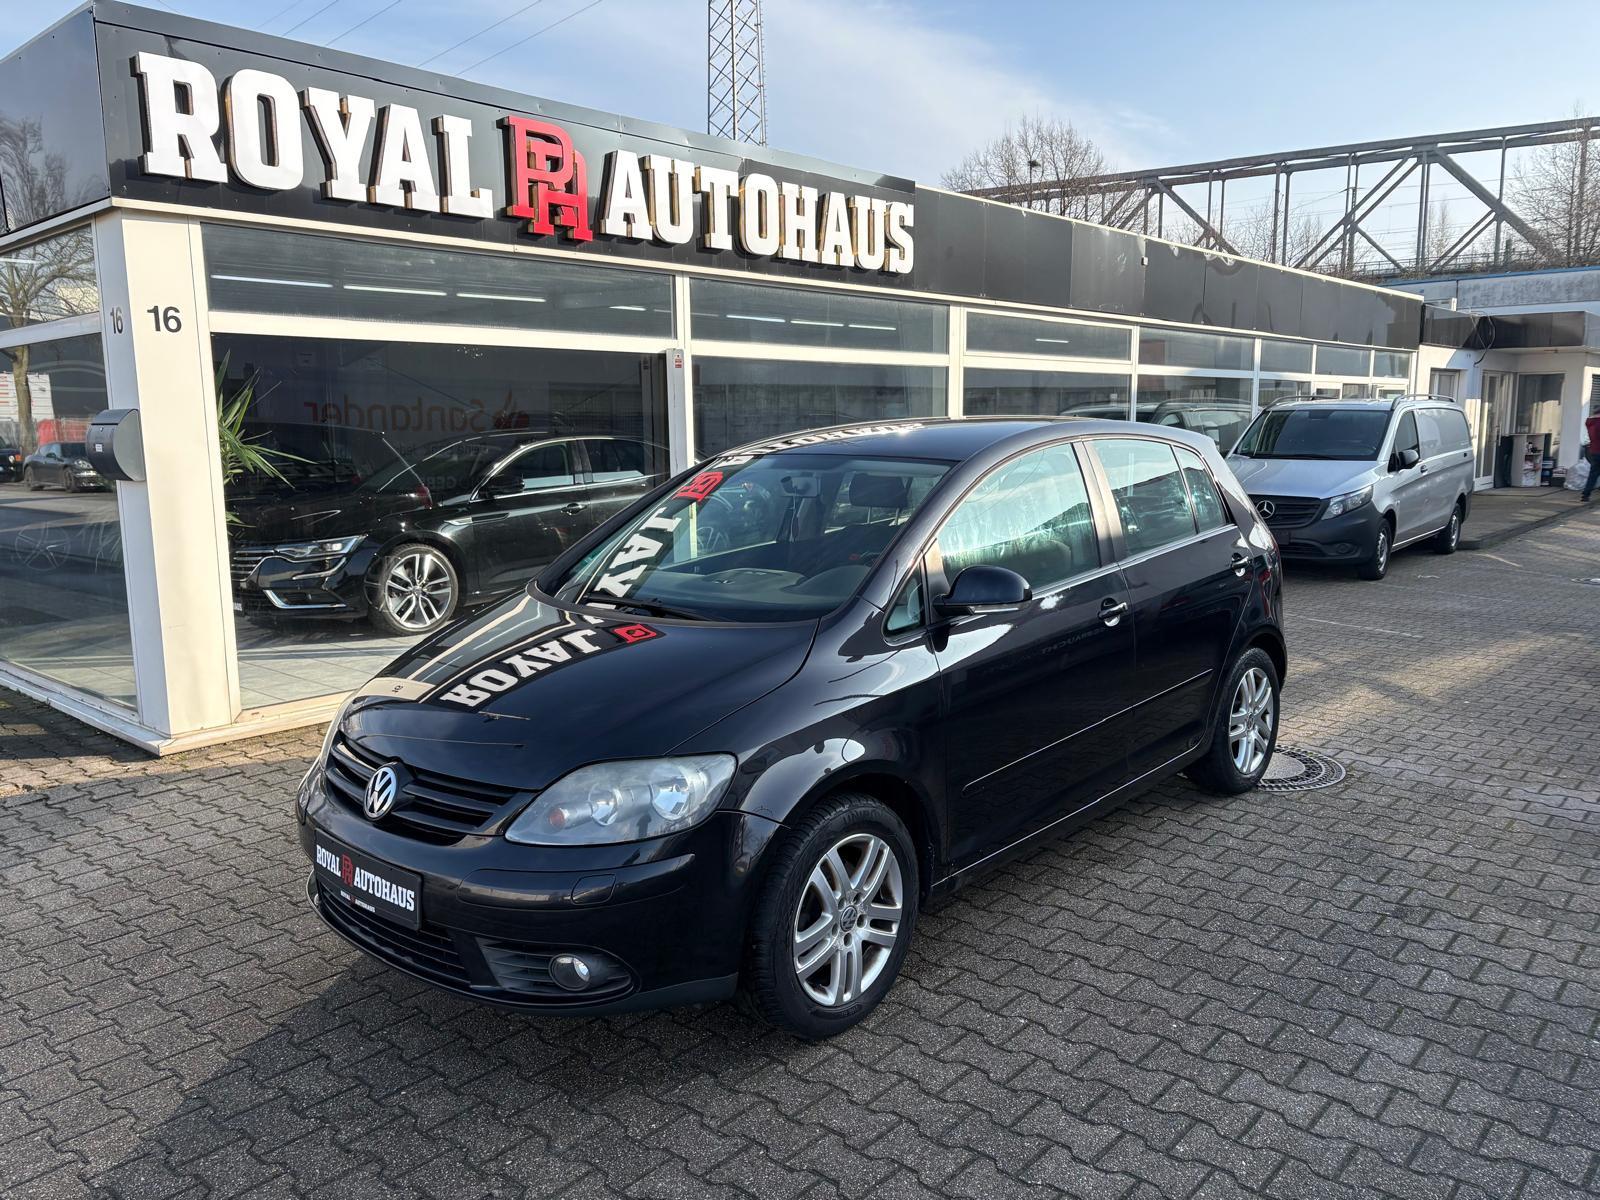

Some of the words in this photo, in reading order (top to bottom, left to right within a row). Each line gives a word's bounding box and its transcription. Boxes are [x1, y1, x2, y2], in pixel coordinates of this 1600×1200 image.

[131, 51, 493, 219] ROYAL
[600, 149, 915, 275] AUTOHAUS
[110, 306, 124, 334] 16
[146, 305, 183, 333] 16
[316, 844, 341, 877] ROYAL
[353, 866, 415, 912] AUTOHAUS
